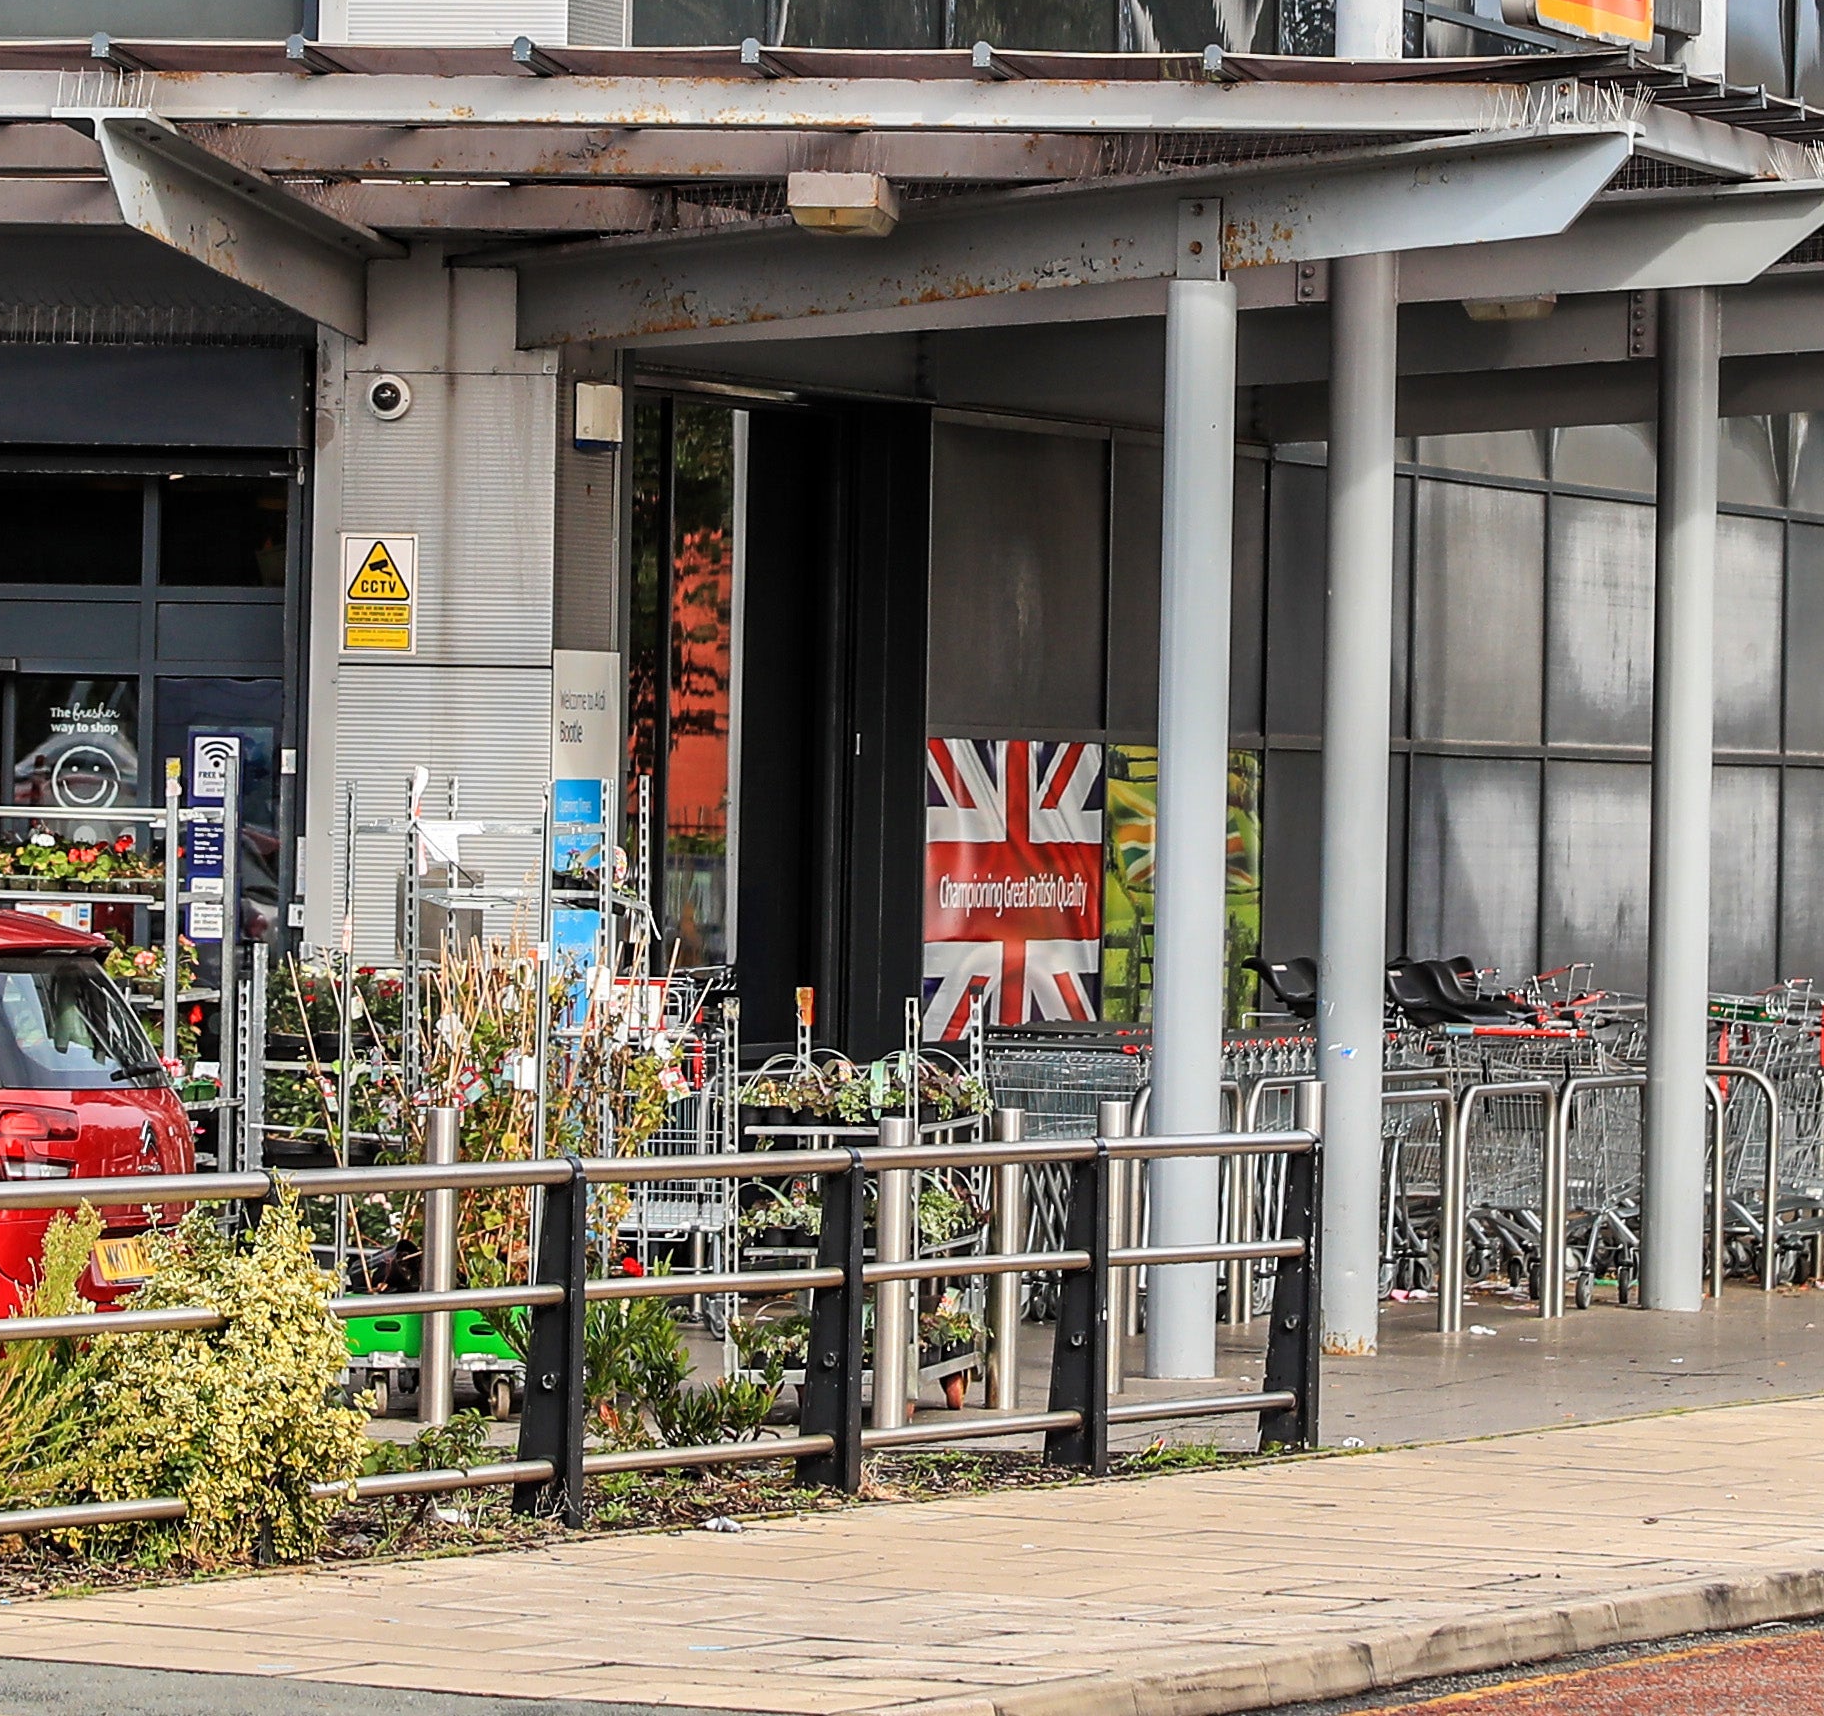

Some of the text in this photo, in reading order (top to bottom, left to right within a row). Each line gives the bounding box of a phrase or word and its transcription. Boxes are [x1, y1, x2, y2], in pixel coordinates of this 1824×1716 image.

[360, 579, 397, 594] CCTV
[560, 689, 606, 711] Welcome to Aldi
[50, 702, 120, 721] The fresher
[50, 722, 118, 735] way to shop
[560, 719, 583, 743] Bootle
[198, 770, 217, 779] FREE
[939, 873, 1088, 917] Championing Great British Quality
